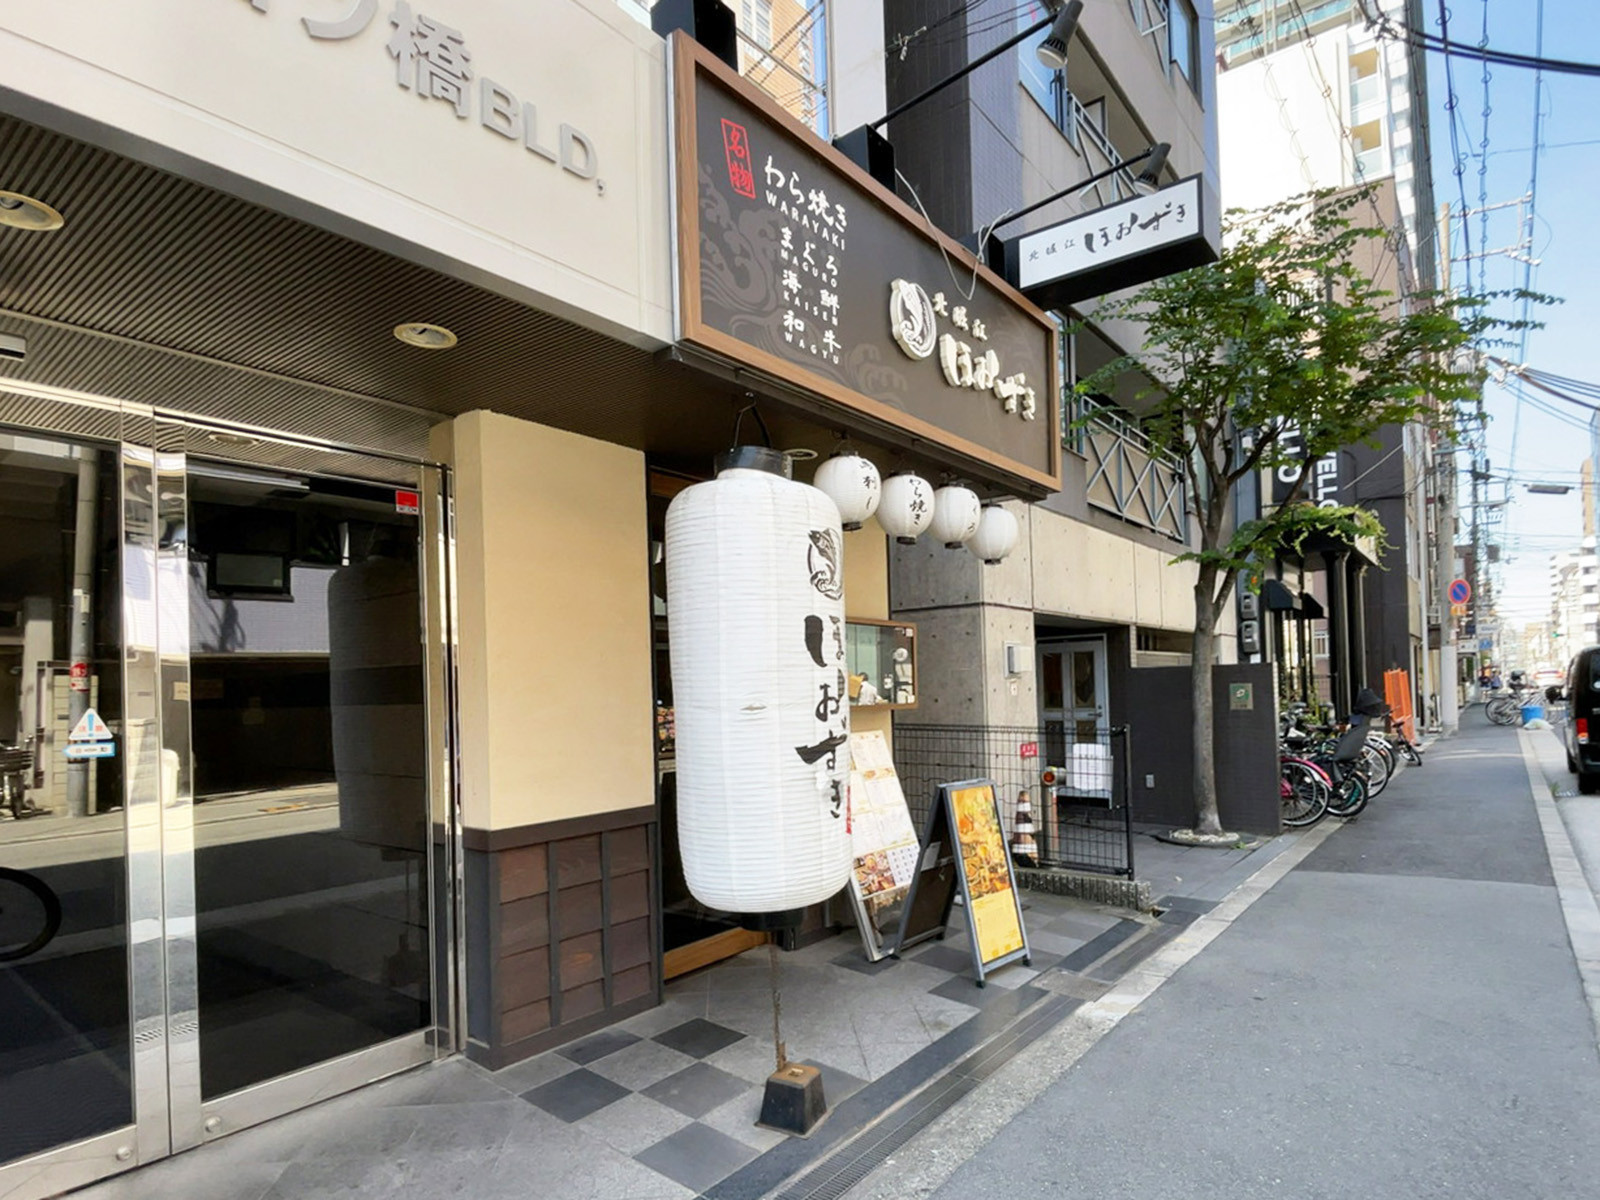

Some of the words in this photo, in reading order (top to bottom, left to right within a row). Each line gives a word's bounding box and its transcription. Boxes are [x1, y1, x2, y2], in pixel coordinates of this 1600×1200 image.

[728, 127, 752, 193] 名物
[765, 155, 848, 233] わら焼き
[765, 190, 845, 251] WARAYAKI
[1084, 202, 1186, 253] ほおずき
[780, 226, 839, 276] まぐろ
[780, 249, 838, 288] MAGURO
[782, 269, 841, 316] 海鮮
[783, 291, 838, 326] KAISEN
[782, 311, 841, 354] 和牛
[785, 331, 839, 365] WAGYU
[909, 478, 928, 526] わら焼き
[794, 614, 848, 819] ほおずき
